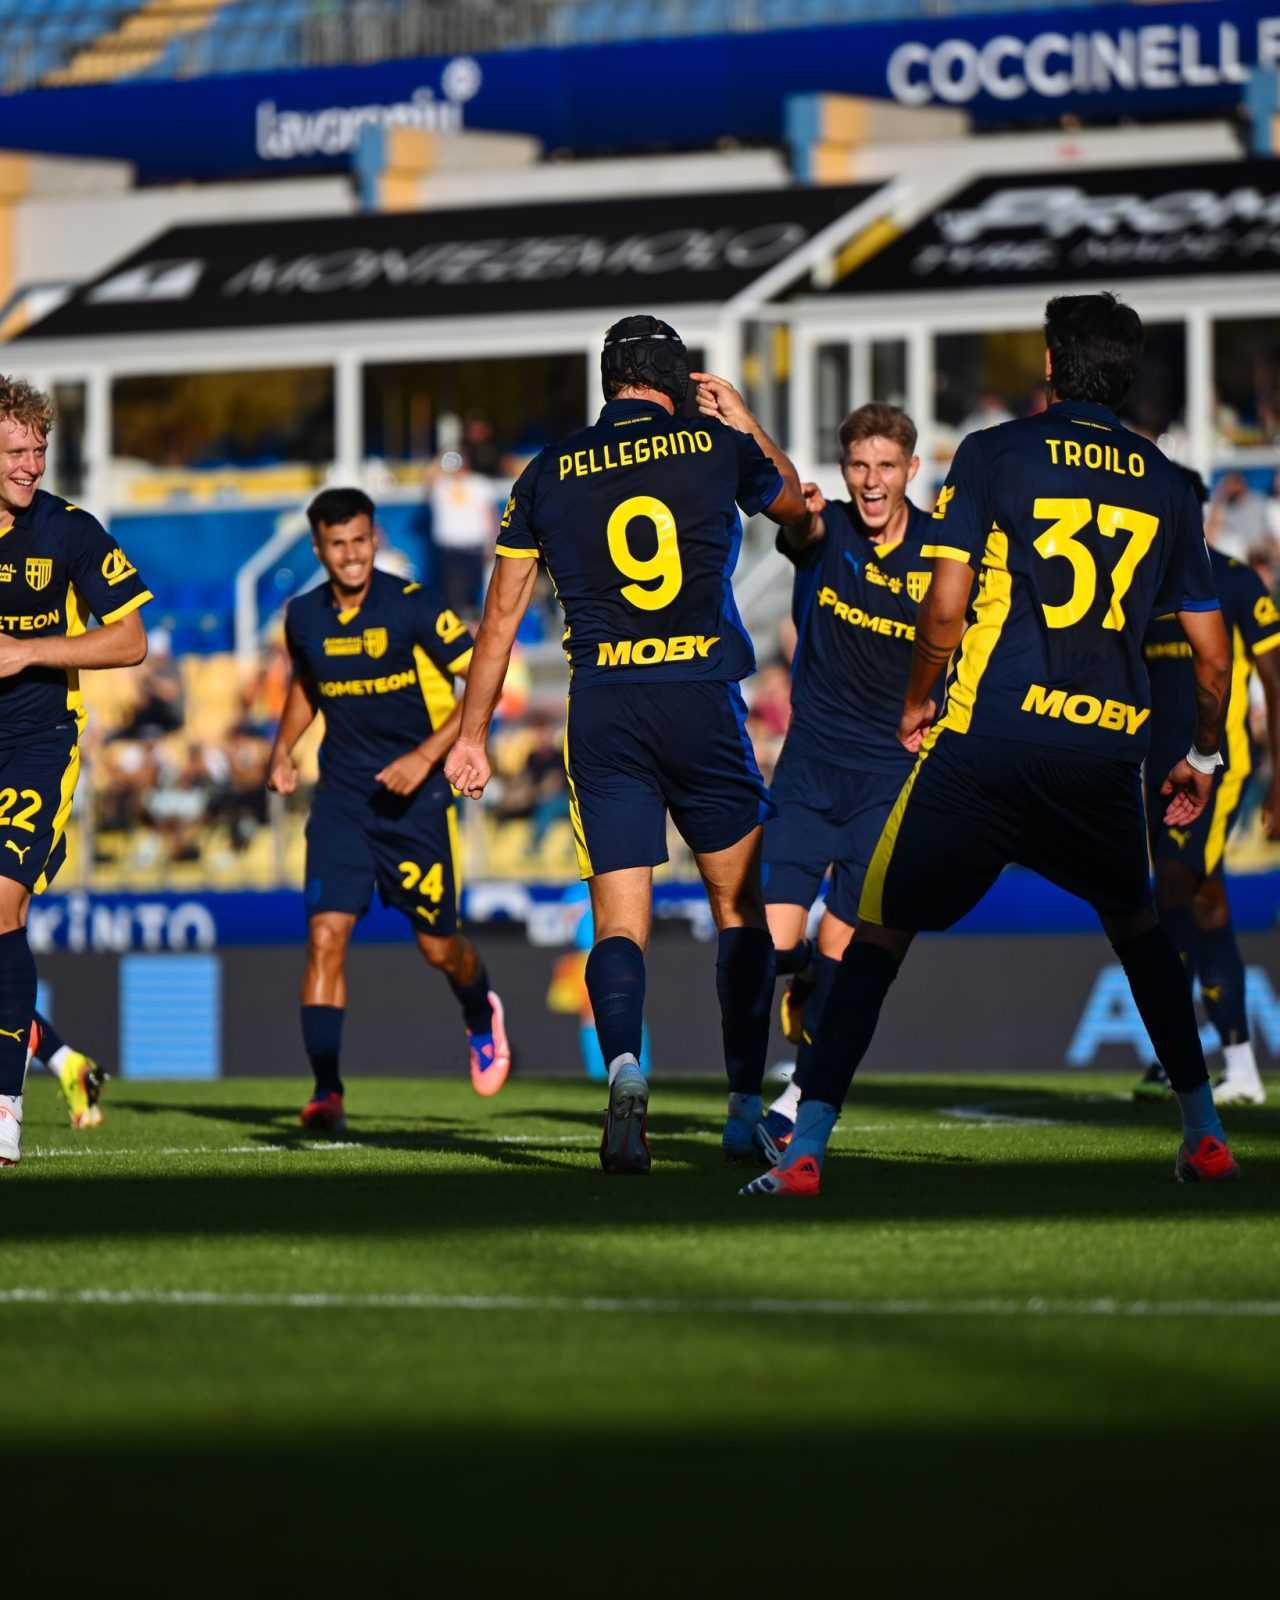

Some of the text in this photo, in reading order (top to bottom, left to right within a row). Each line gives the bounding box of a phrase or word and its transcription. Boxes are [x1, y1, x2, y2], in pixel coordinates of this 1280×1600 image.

[559, 430, 713, 480] PELLEGRINO
[1045, 439, 1146, 478] TROILO
[607, 495, 683, 611] 9
[1033, 498, 1160, 632] 37
[596, 635, 720, 667] MOBY
[1021, 684, 1151, 736] MOBY
[0, 787, 43, 833] 22
[398, 861, 444, 903] 24
